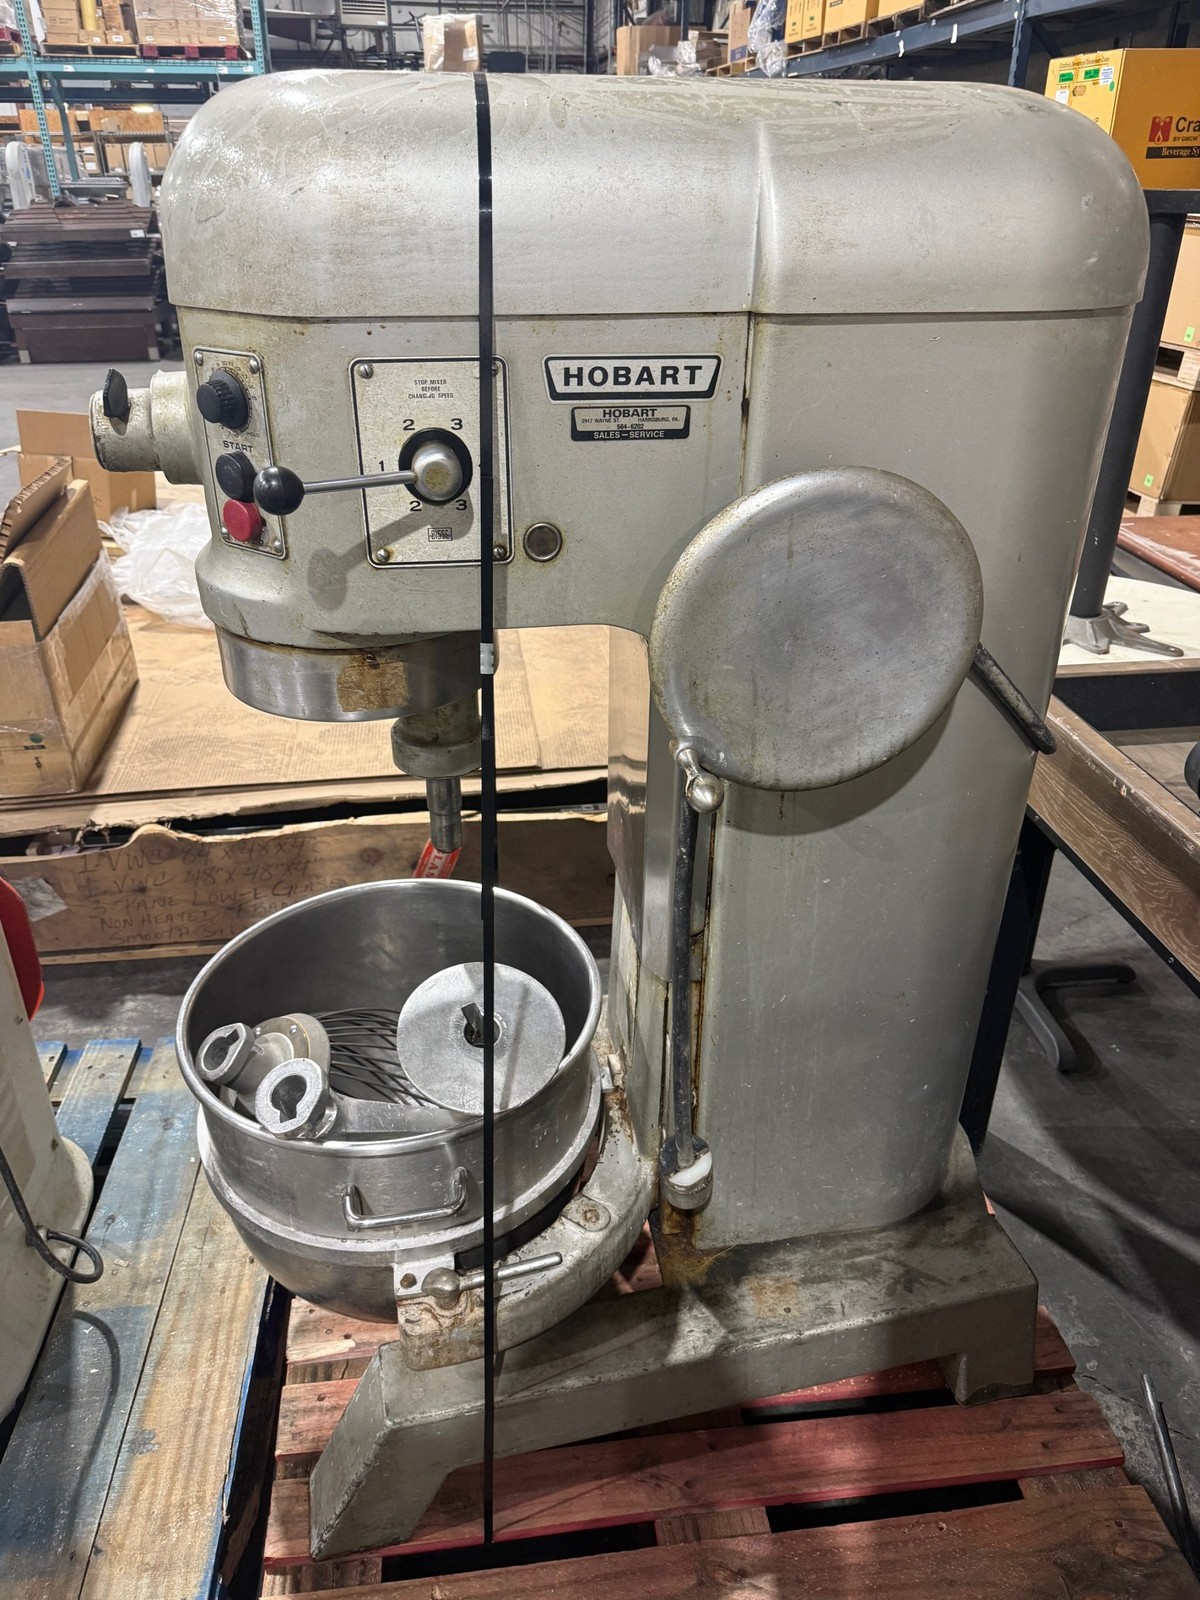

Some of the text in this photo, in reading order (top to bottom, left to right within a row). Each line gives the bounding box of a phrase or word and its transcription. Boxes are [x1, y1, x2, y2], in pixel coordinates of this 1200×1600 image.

[1161, 147, 1191, 157] Beverage
[563, 365, 702, 386] HOBART
[602, 408, 658, 418] HOBART
[402, 418, 463, 431] 2 3
[593, 431, 620, 439] SALES
[629, 430, 665, 438] SERVICE
[222, 440, 253, 453] START
[379, 460, 385, 472] 1
[409, 499, 468, 512] 2 3
[425, 854, 444, 878] LAS
